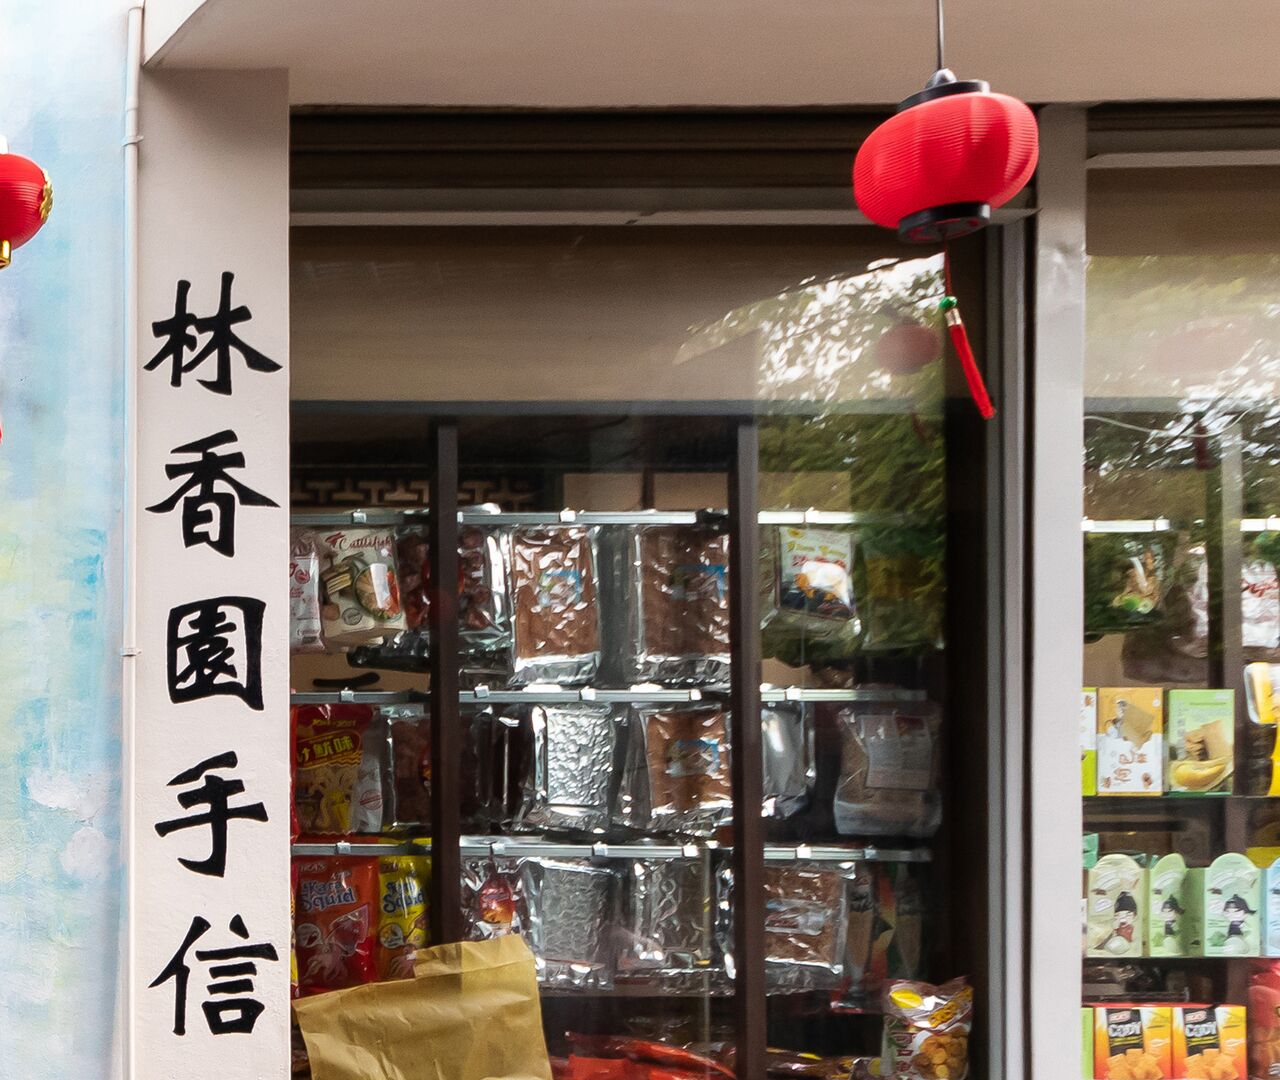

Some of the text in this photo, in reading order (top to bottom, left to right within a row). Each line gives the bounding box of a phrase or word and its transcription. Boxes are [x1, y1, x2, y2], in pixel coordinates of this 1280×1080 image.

[143, 271, 283, 1036] 林香園手信
